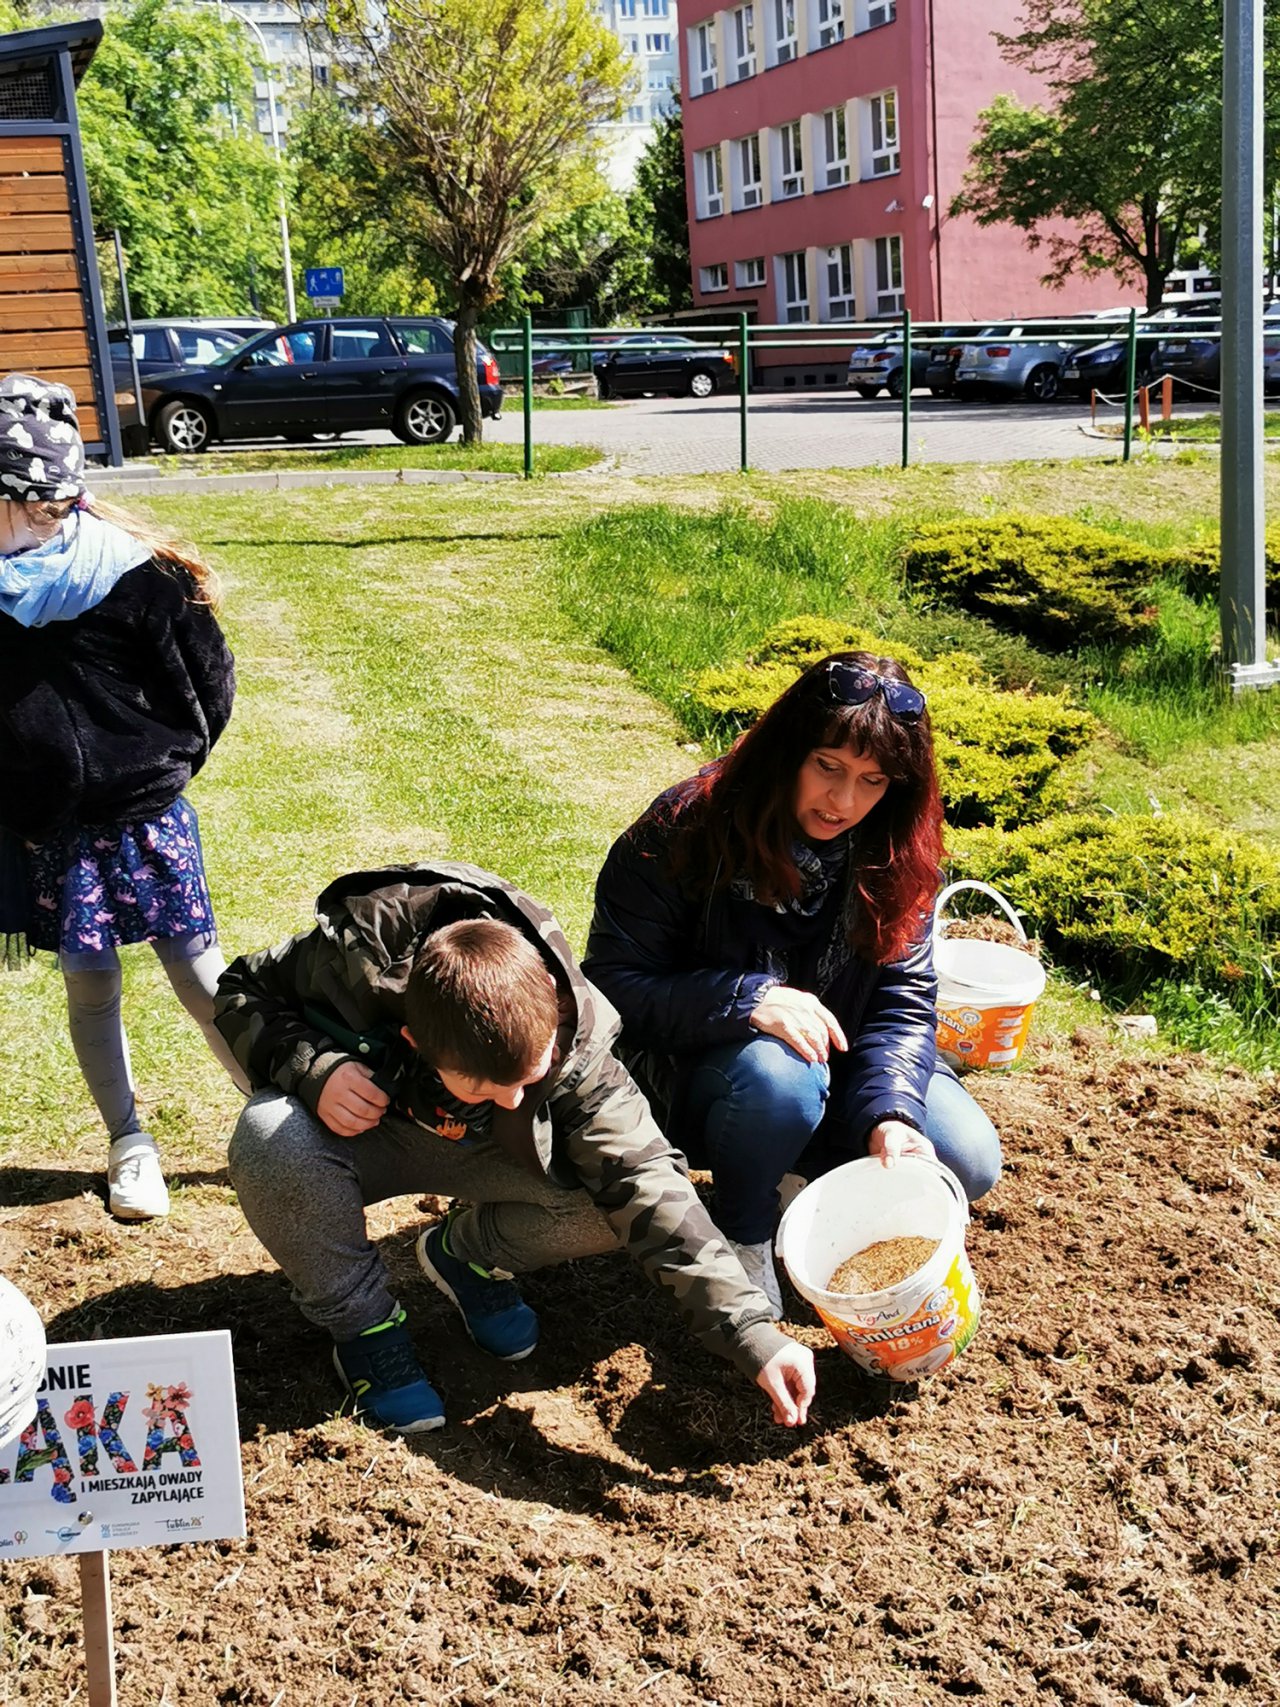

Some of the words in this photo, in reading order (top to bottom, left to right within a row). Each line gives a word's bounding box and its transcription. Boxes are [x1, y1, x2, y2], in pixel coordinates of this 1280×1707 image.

[936, 1011, 966, 1035] etana
[0, 1382, 202, 1504] ĄKA
[81, 1481, 86, 1493] I
[89, 1475, 156, 1492] MIESZKAJĄ
[159, 1470, 203, 1486] OWADY
[131, 1486, 205, 1505] ZAPYLAJĄCE
